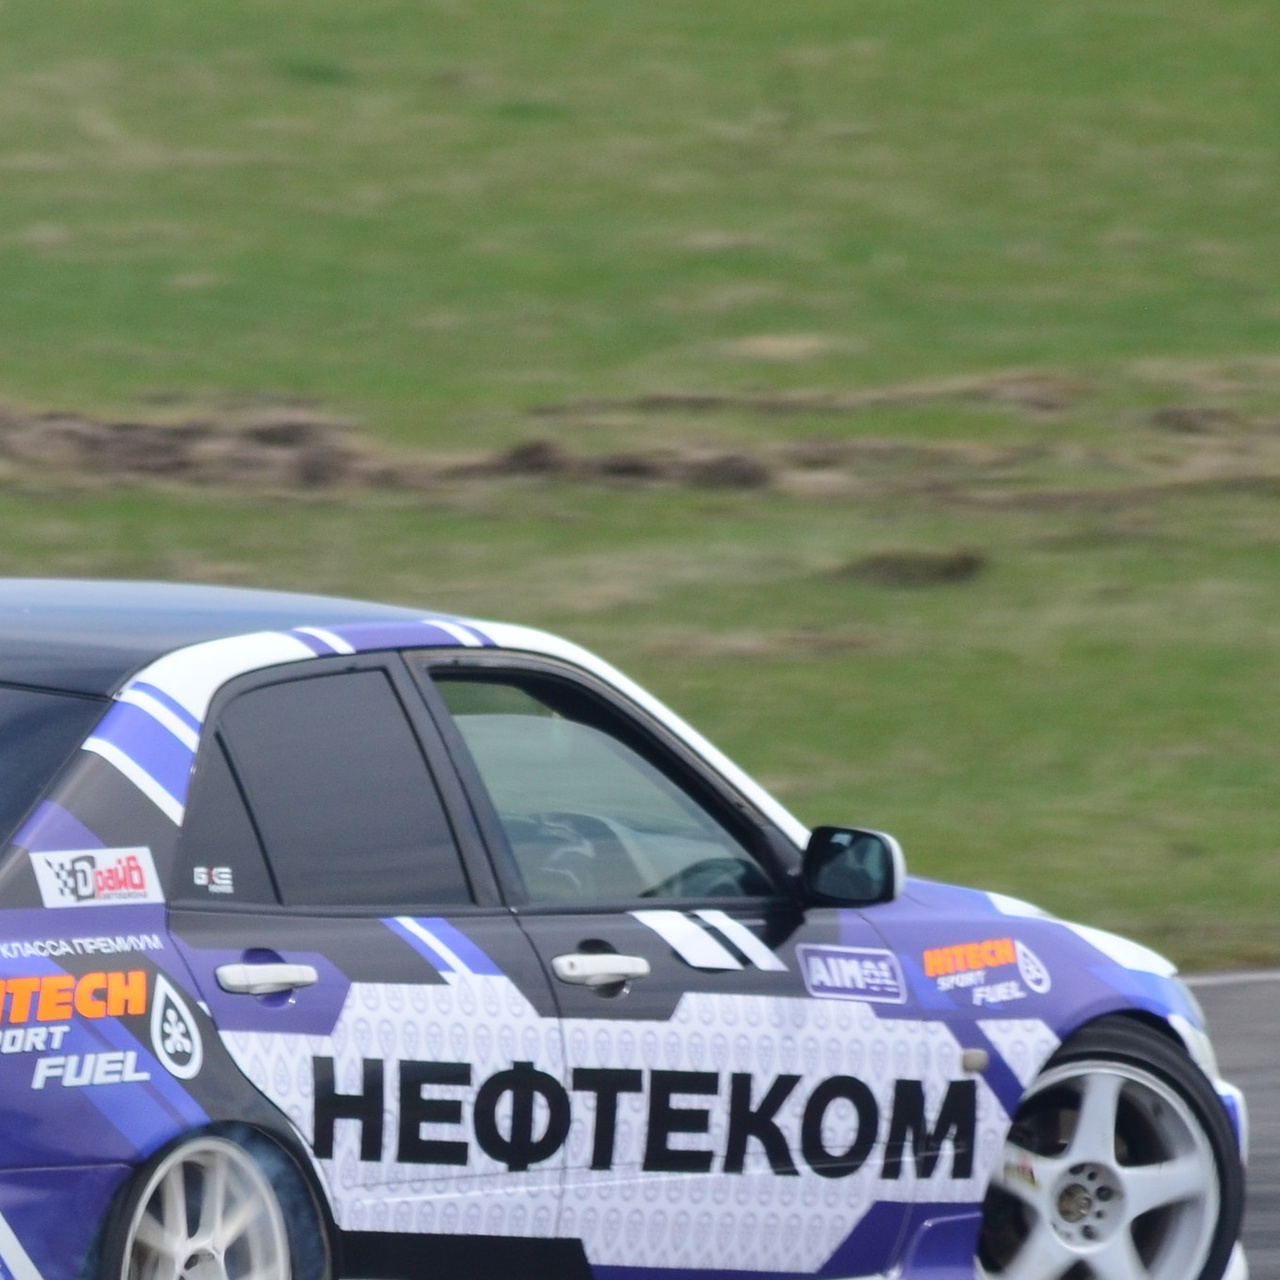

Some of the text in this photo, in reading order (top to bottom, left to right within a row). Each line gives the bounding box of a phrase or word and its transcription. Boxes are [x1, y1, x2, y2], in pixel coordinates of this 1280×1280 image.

[72, 933, 164, 956] ПРЕМИУМ
[923, 937, 1017, 977] HITECH
[936, 970, 986, 992] SPORT
[972, 980, 1027, 1006] FUEL
[31, 1051, 151, 1090] FUEL
[311, 1055, 977, 1180] НЕФТЕКОМ
